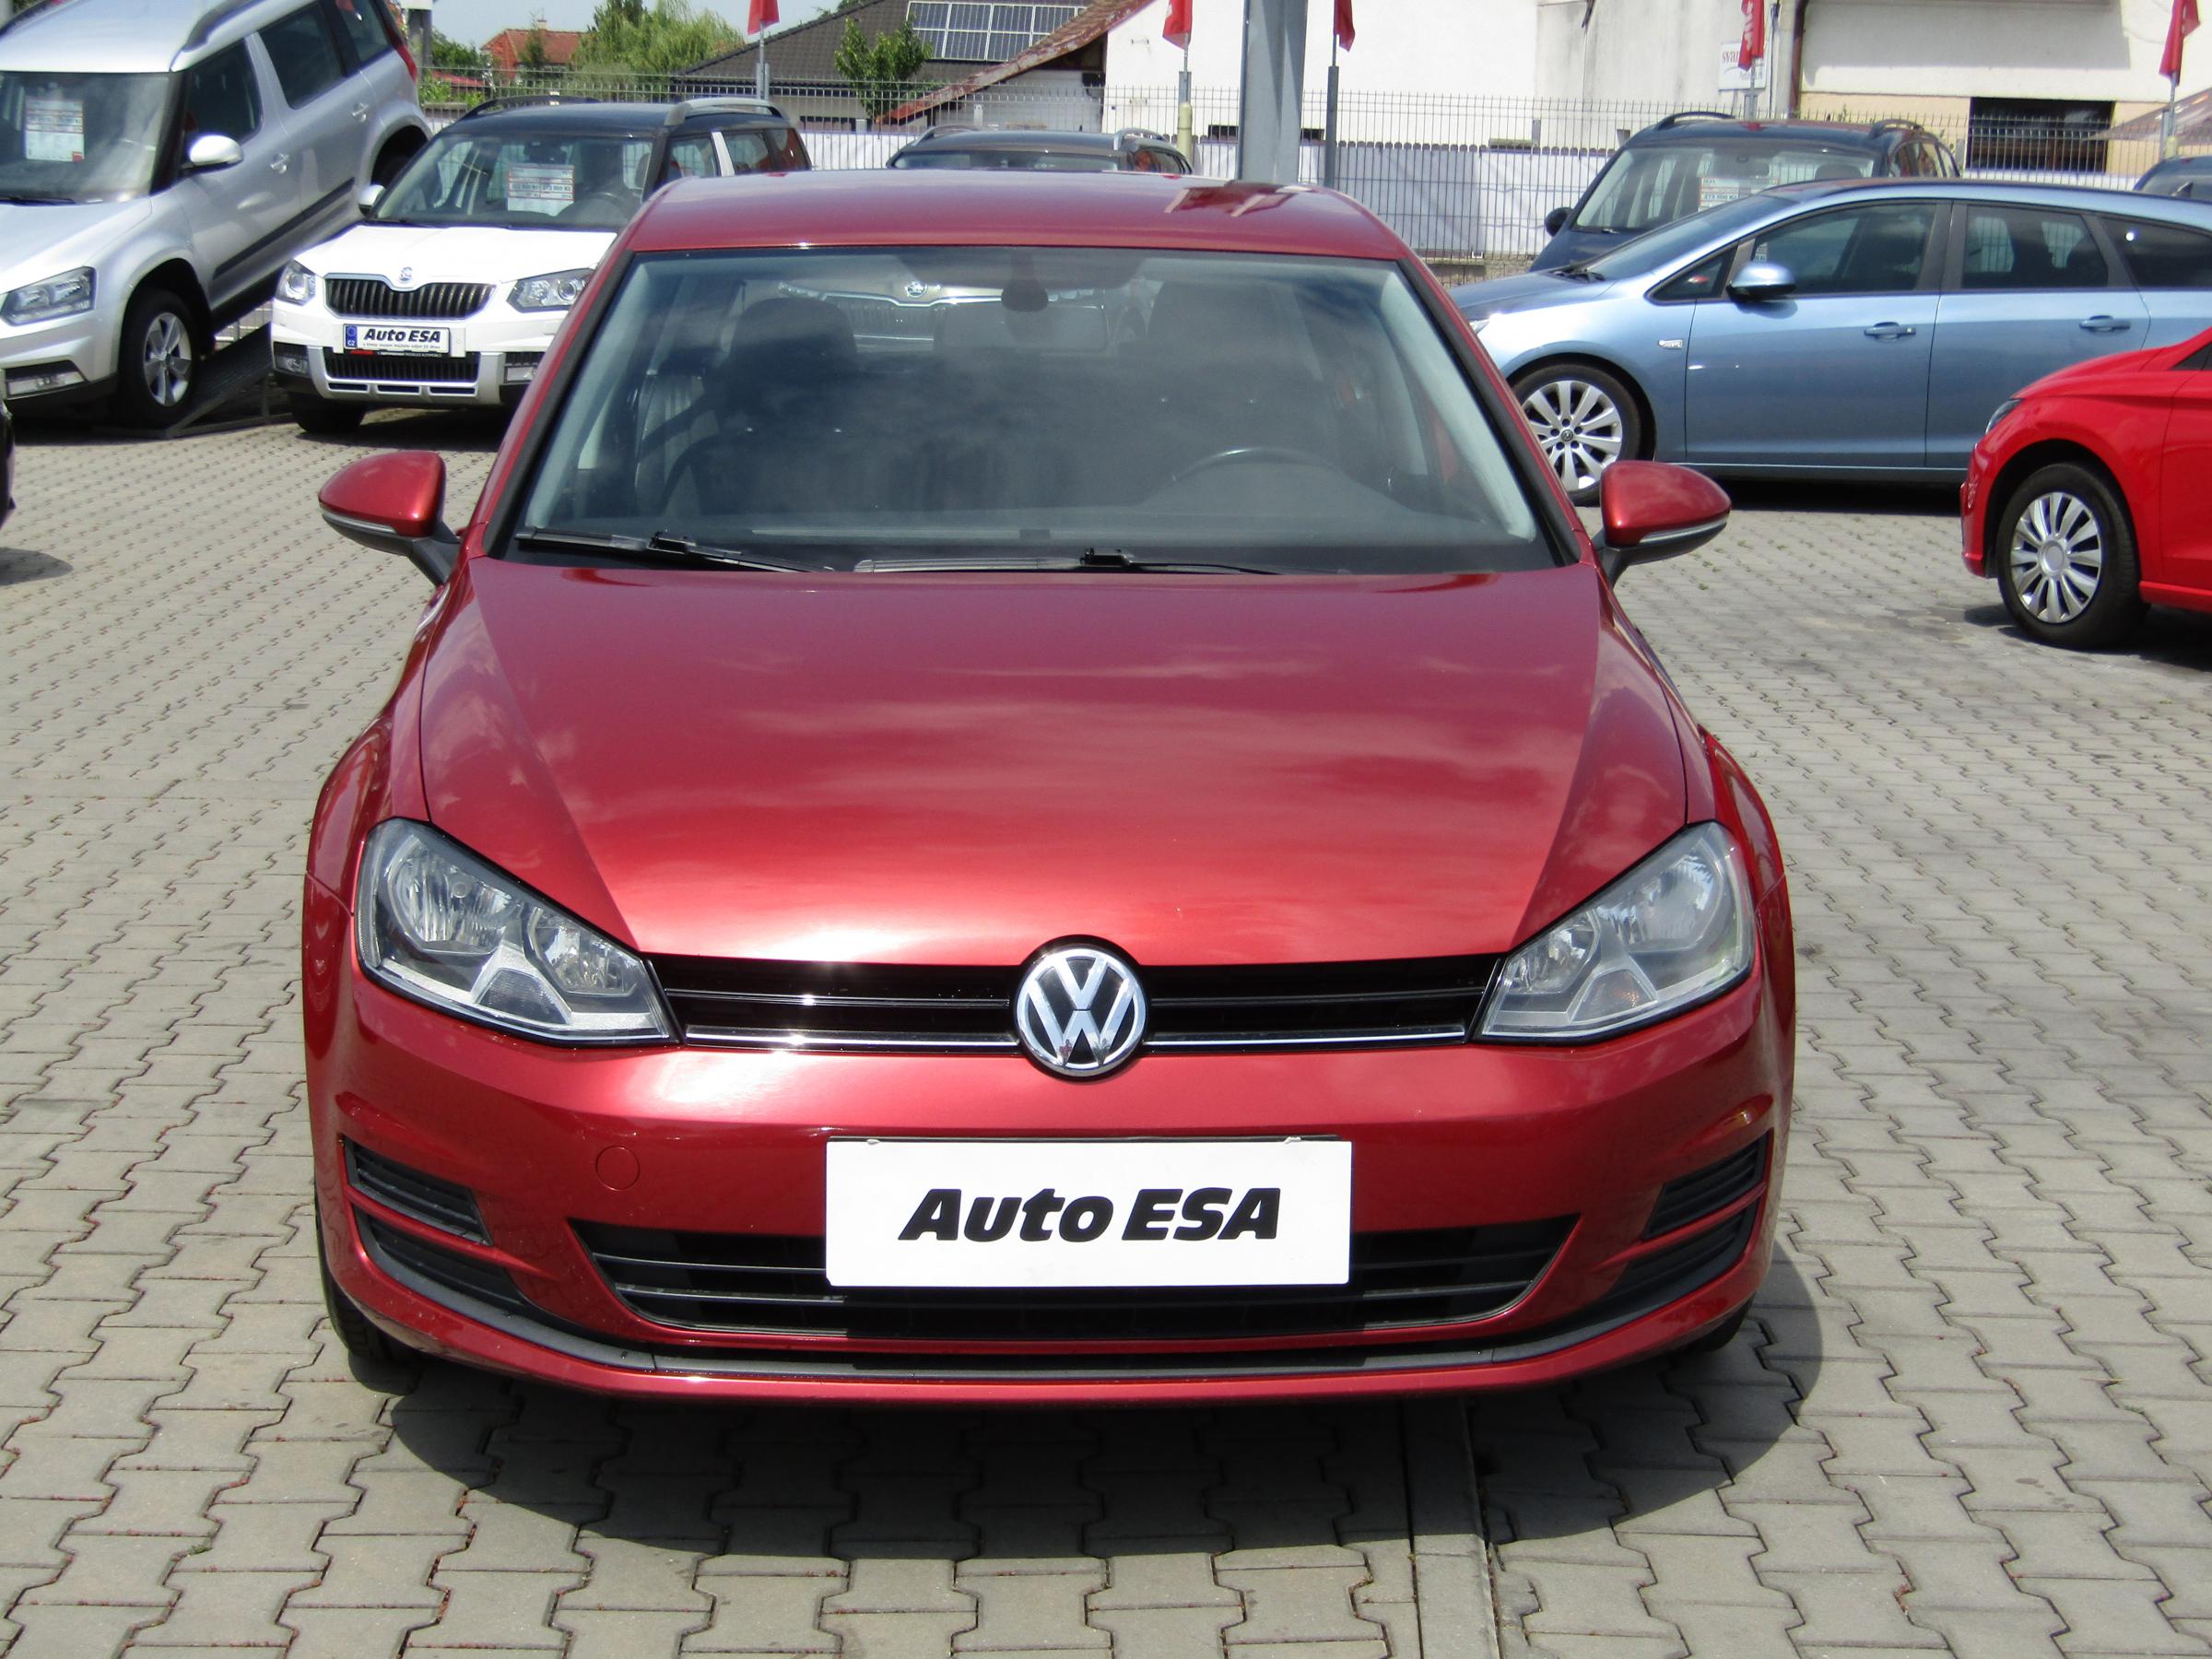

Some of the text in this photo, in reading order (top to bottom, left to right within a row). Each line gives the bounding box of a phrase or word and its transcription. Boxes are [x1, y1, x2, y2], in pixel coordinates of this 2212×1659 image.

[364, 328, 441, 343] Auto ESA
[1019, 951, 1143, 1073] VW
[898, 1187, 1282, 1242] Auto ESA
